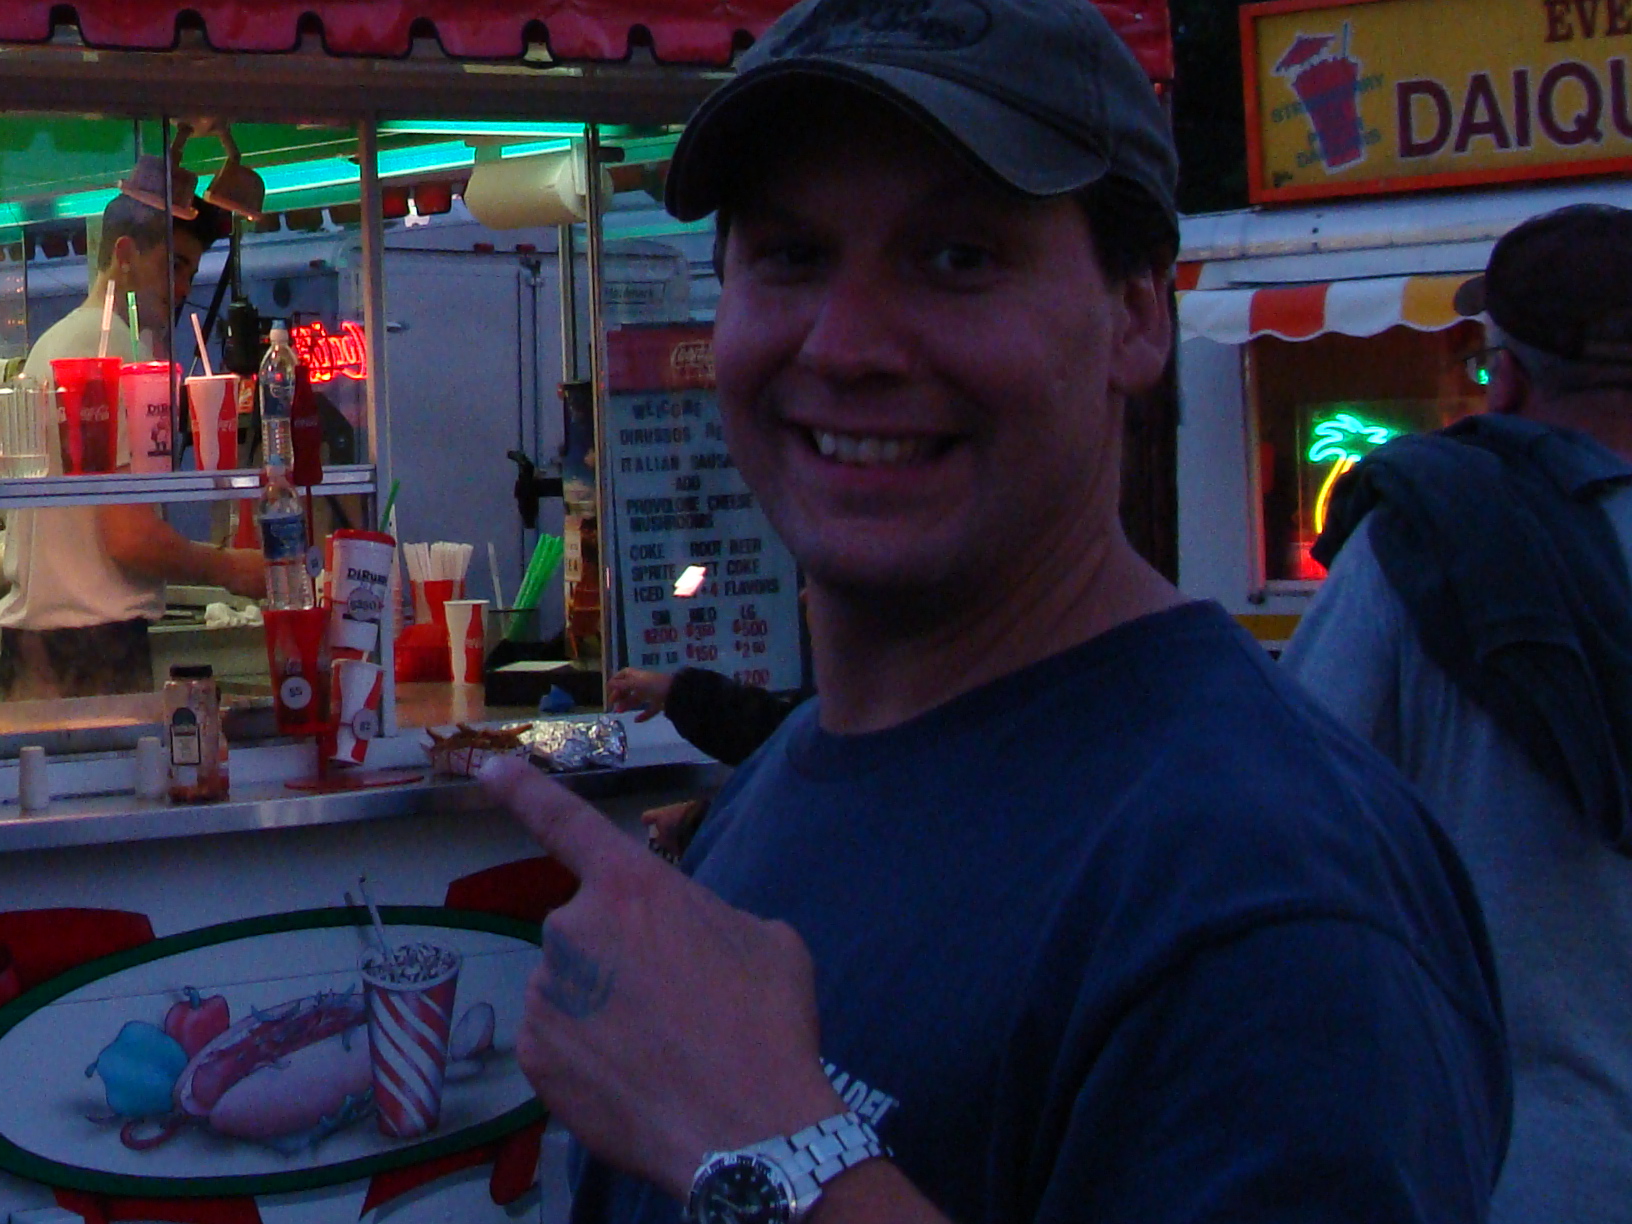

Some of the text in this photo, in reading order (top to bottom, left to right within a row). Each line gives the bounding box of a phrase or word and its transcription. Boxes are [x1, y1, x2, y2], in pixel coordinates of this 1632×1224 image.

[689, 453, 735, 470] SAUSA
[630, 543, 665, 561] COKE
[634, 585, 664, 603] ICED
